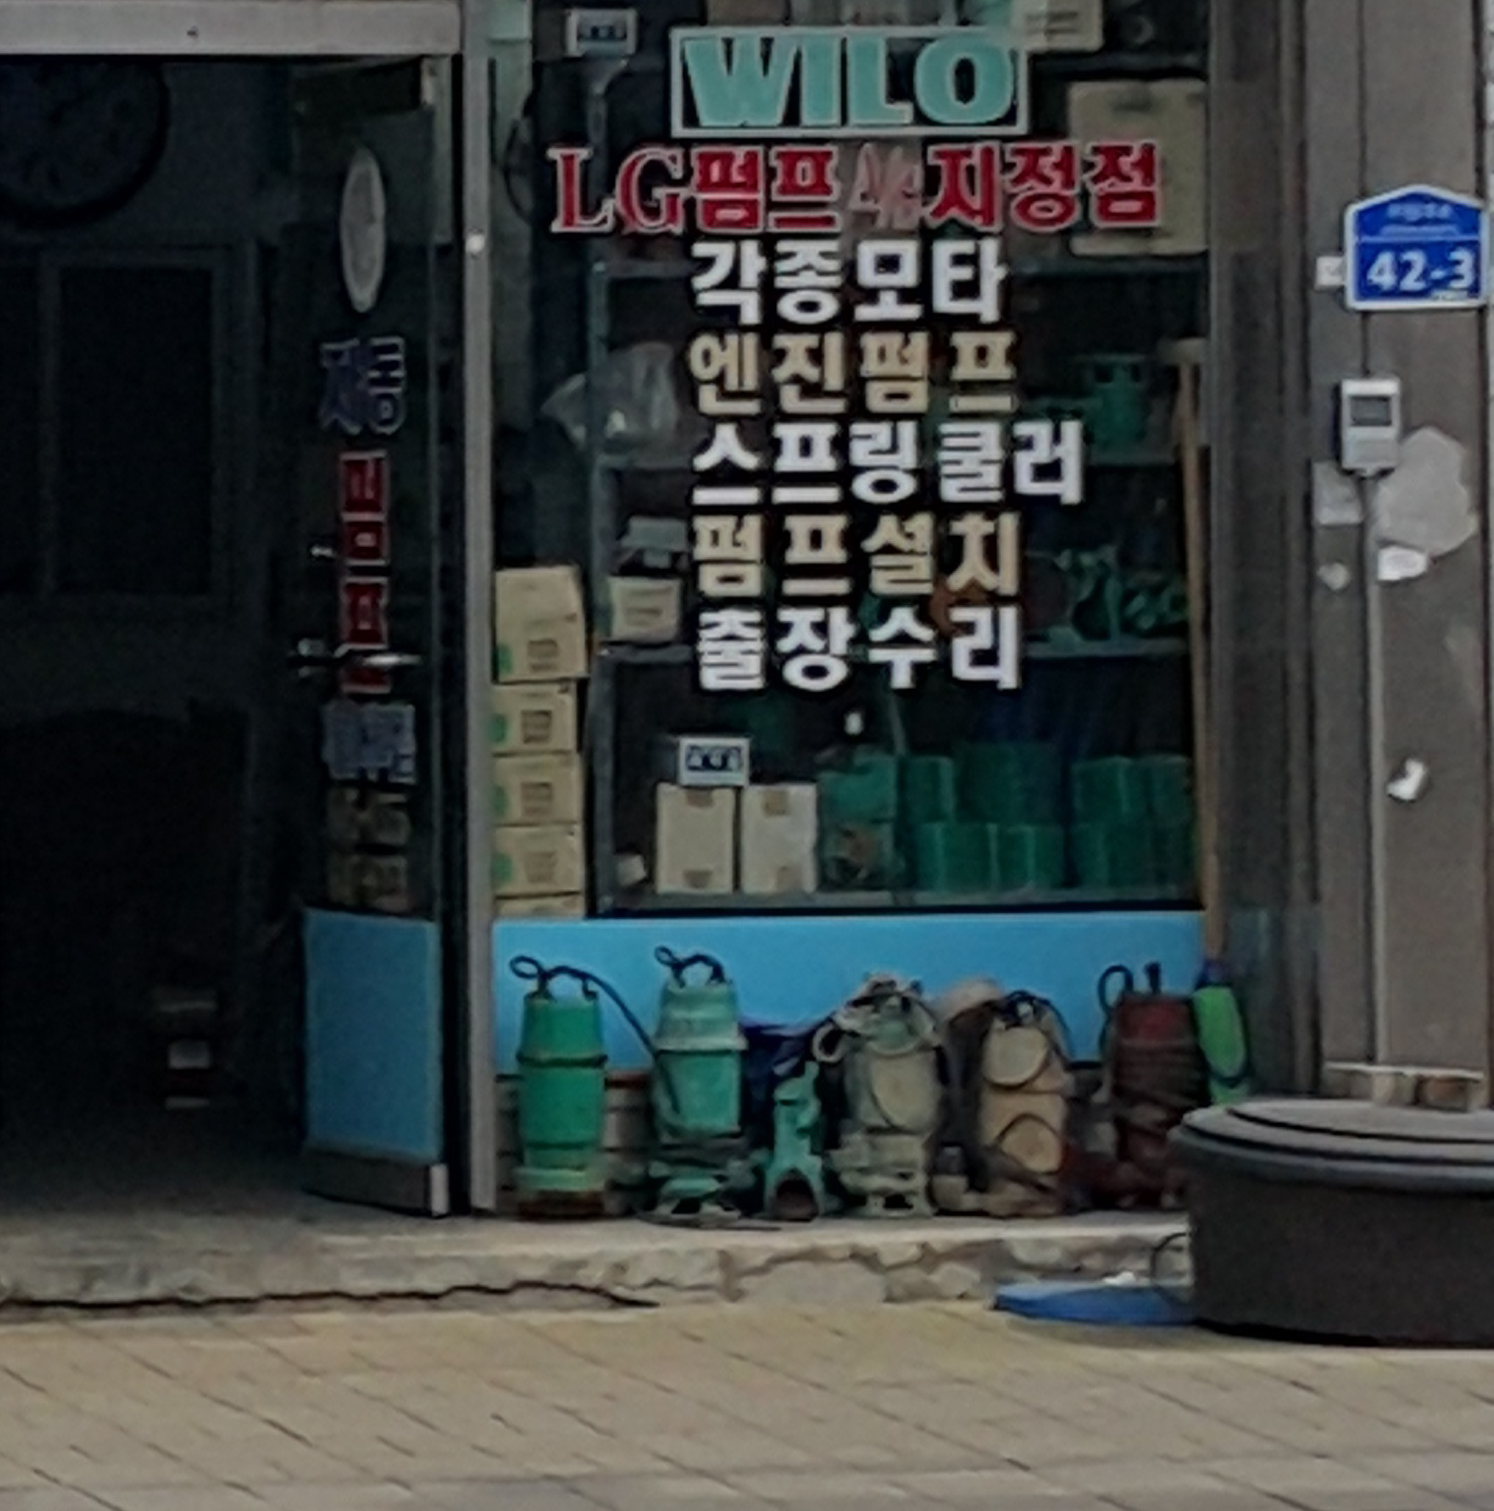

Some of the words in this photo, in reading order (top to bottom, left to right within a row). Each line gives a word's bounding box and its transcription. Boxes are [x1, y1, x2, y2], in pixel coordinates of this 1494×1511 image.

[680, 33, 1016, 128] WILO
[546, 144, 841, 233] LG펌프
[924, 140, 1162, 232] 지정점
[690, 238, 1006, 325] 각종모타
[1366, 250, 1475, 293] 42-3
[689, 330, 1017, 415] 엔진펌프
[690, 420, 1084, 506] 스프링쿨러
[691, 511, 1021, 598] 펌프설치
[696, 604, 1022, 691] 출장수리
